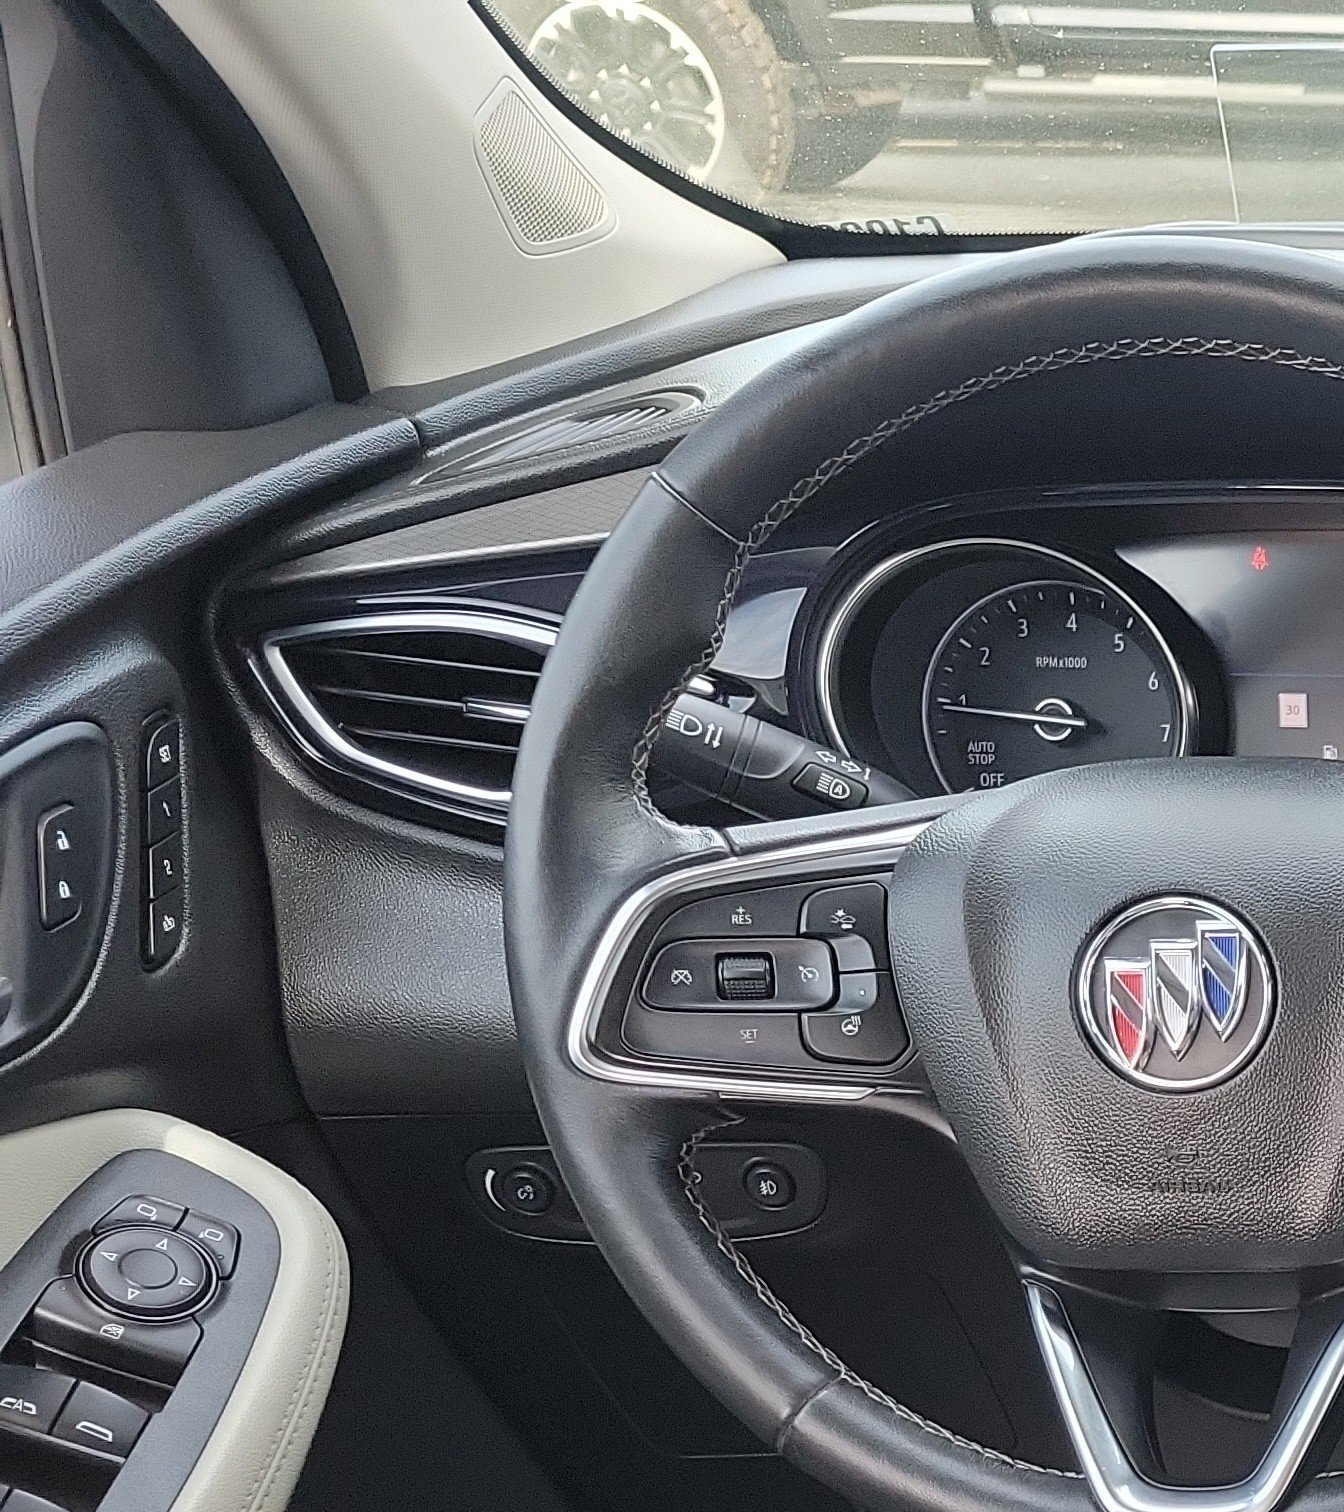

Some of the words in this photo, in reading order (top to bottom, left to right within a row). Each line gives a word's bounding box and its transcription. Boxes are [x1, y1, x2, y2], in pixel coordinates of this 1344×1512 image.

[1018, 619, 1028, 637] 3
[1066, 613, 1077, 632] 4
[1114, 634, 1125, 652] 5
[980, 648, 990, 665] 2
[1036, 657, 1087, 669] RPMx1000
[1148, 672, 1158, 690] 6
[958, 694, 966, 705] 1
[1286, 705, 1300, 715] 30
[1160, 724, 1171, 742] 7
[967, 741, 995, 753] AUTO
[968, 754, 995, 765] STOP
[980, 773, 1005, 787] OFF
[731, 914, 752, 925] RES
[740, 1029, 758, 1040] SET
